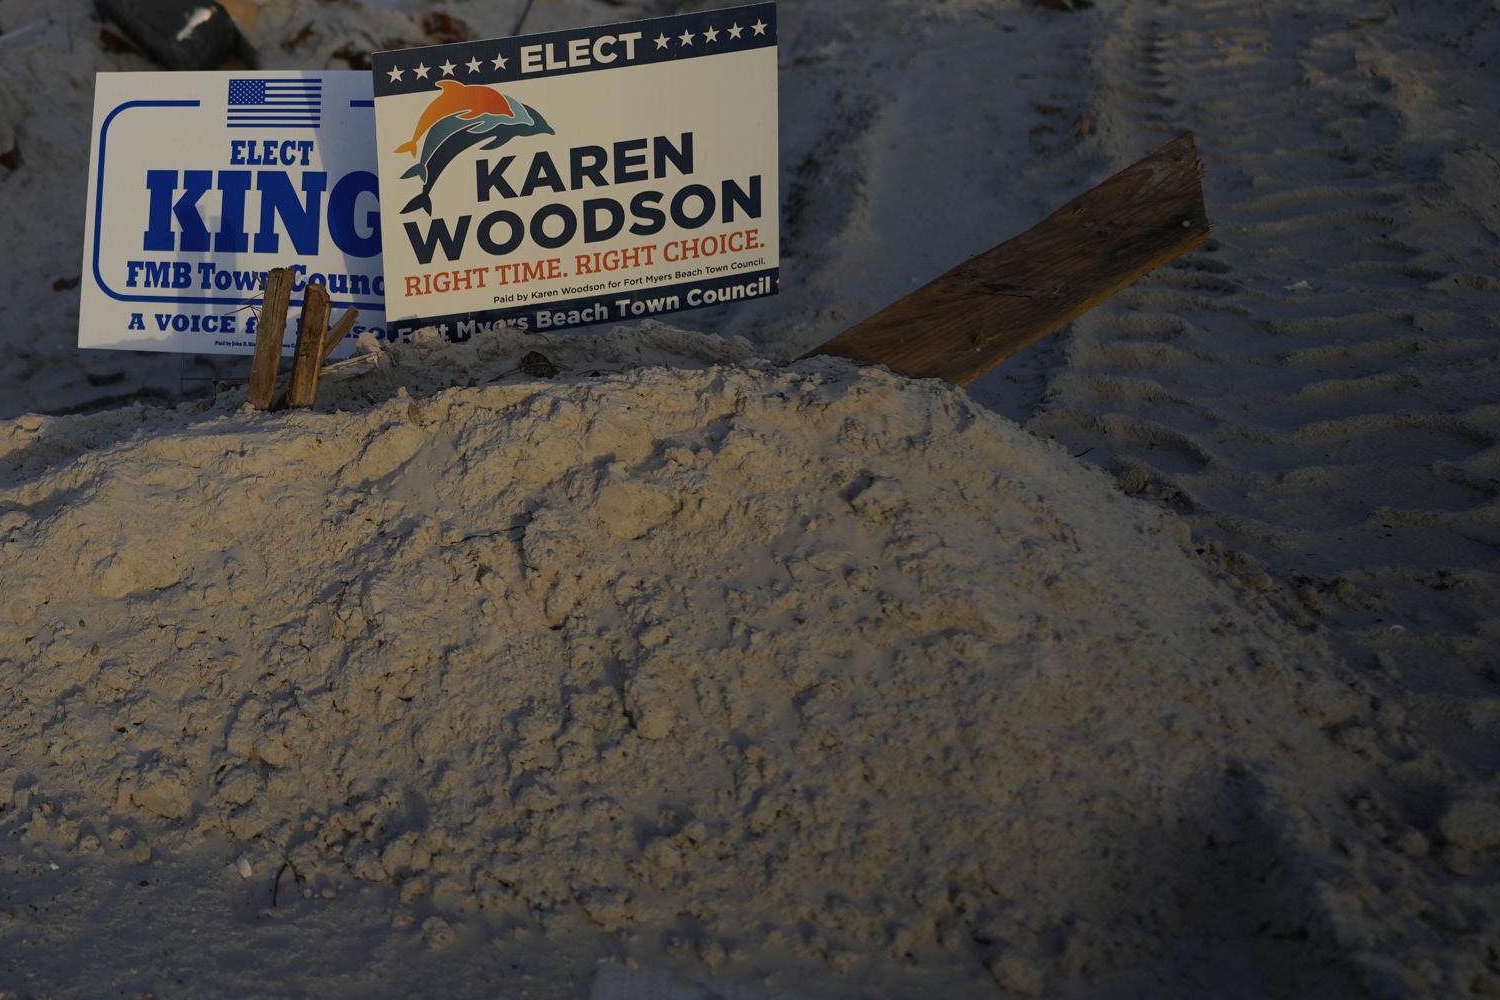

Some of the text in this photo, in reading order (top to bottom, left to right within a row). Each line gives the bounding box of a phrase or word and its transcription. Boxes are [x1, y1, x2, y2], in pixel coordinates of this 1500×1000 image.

[520, 31, 642, 74] ELECT
[230, 140, 314, 165] ELECT
[476, 131, 694, 202] KAREN
[143, 170, 384, 258] KING
[403, 175, 762, 265] WOODSON
[126, 261, 192, 289] FMB
[405, 229, 766, 297] RIGHT TIME. RIGHT CHOICE.
[493, 258, 766, 304] Paid by Karen Woodson for Fort Myers Beach Town Council.
[128, 313, 145, 330] A
[154, 314, 236, 334] VOICE
[397, 323, 449, 344] Ft
[536, 303, 609, 329] Beach
[615, 295, 680, 317] Town
[686, 276, 771, 306] Council
